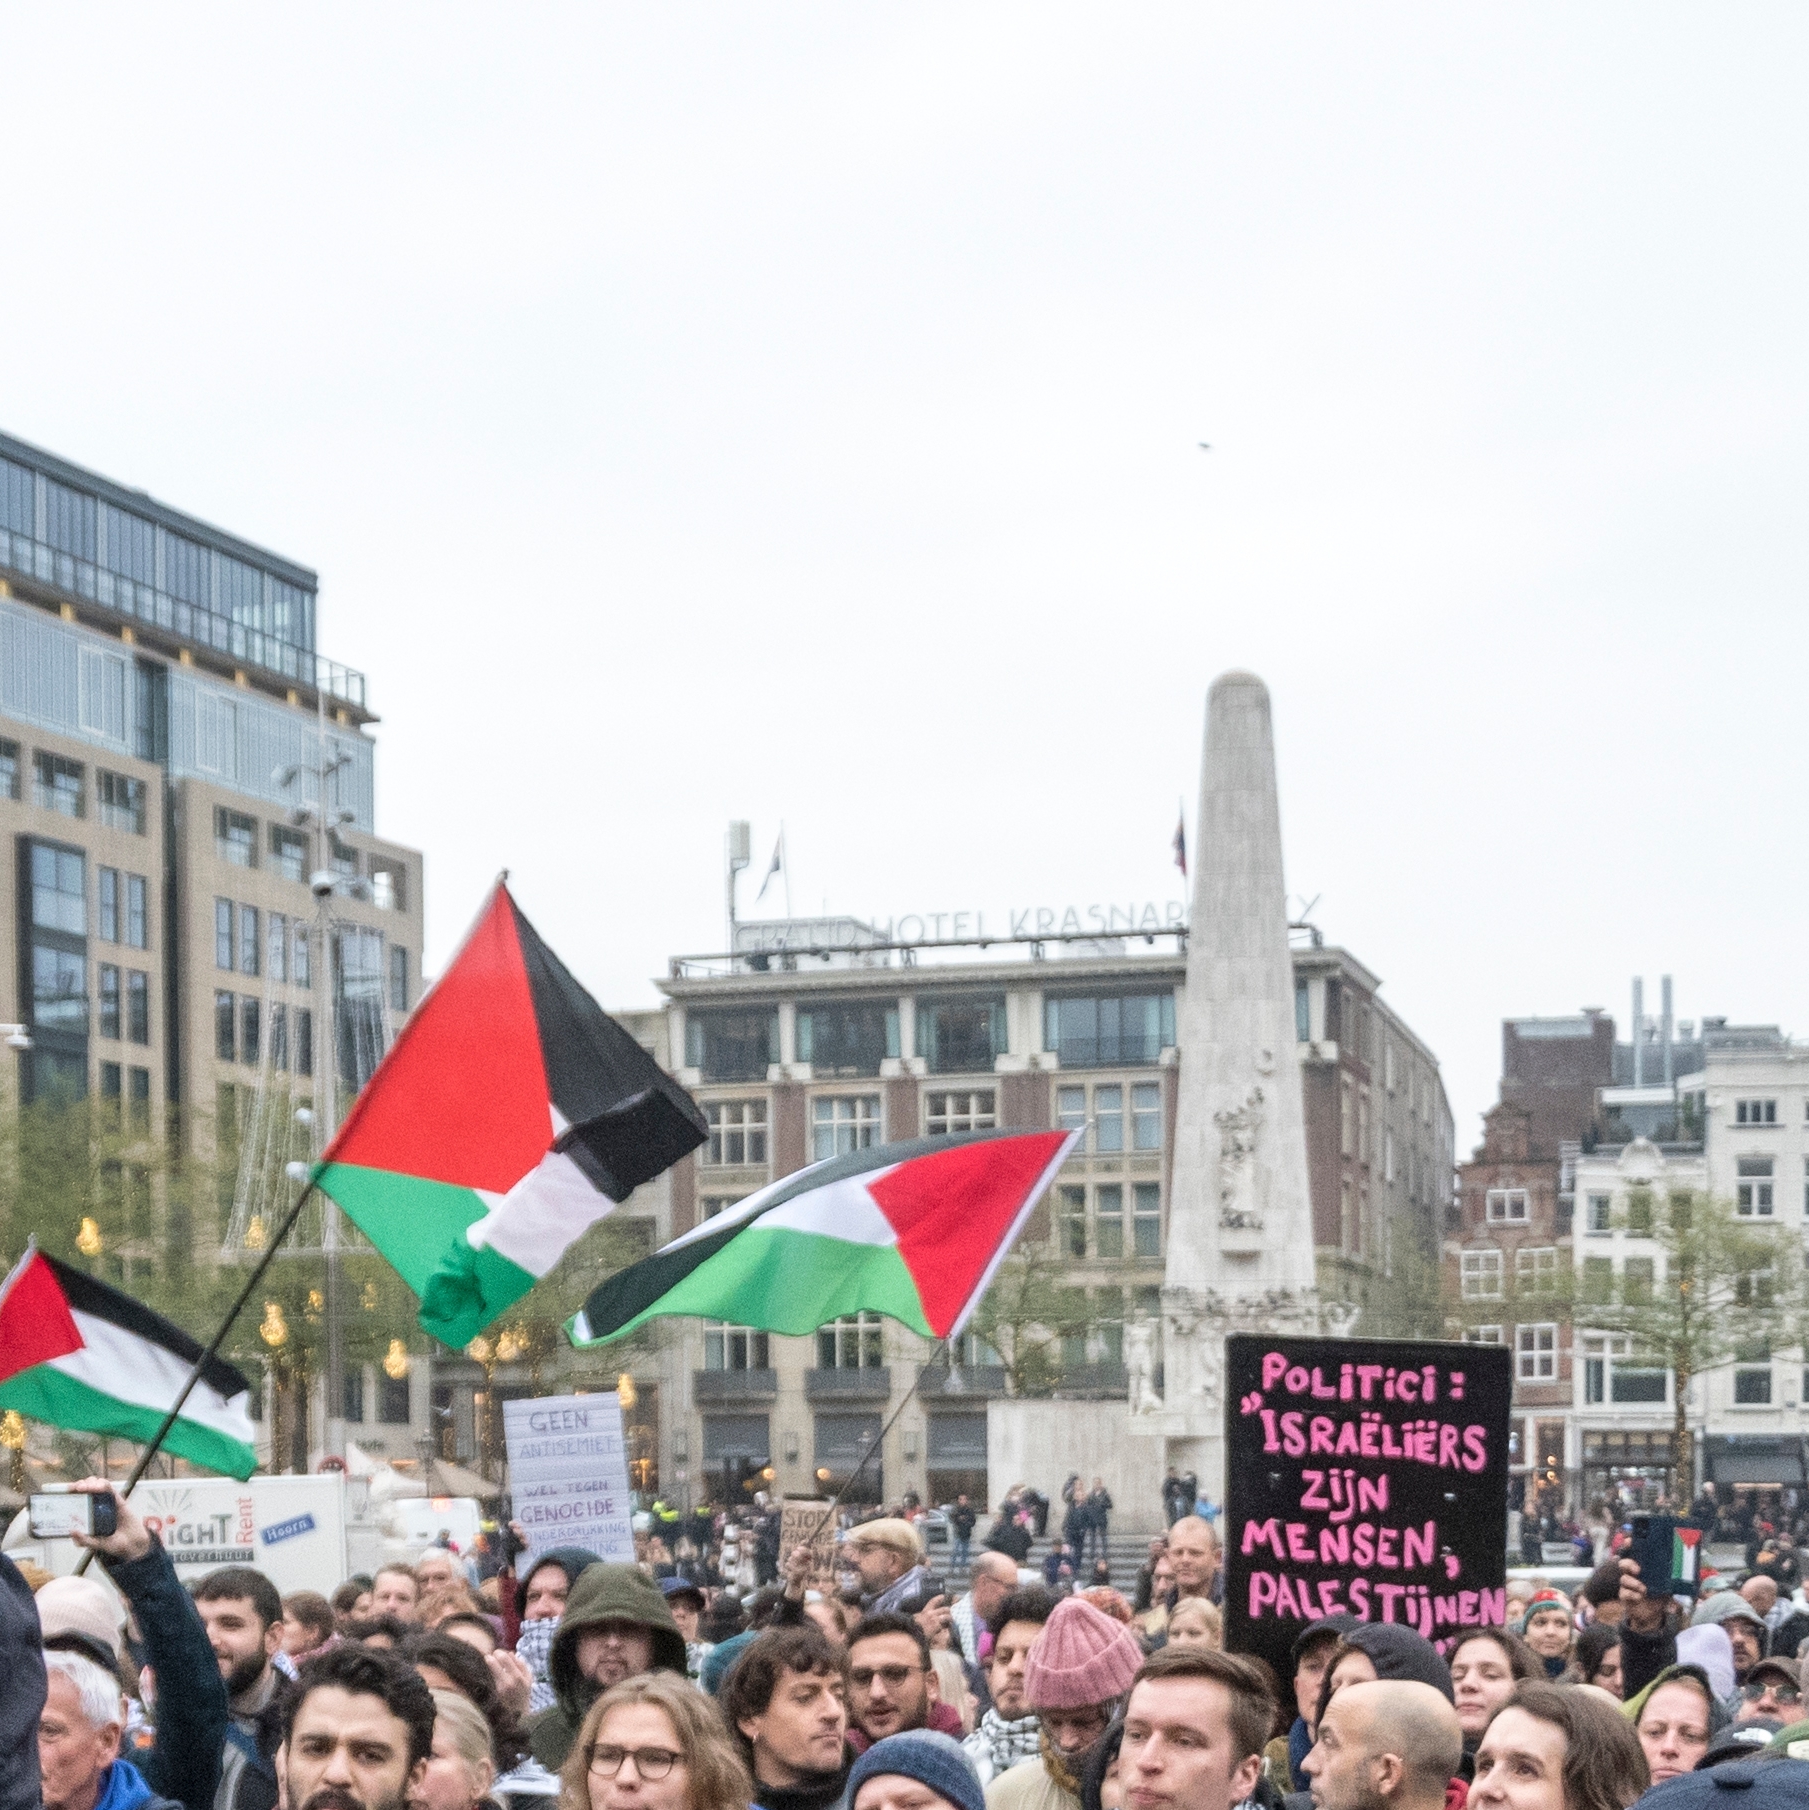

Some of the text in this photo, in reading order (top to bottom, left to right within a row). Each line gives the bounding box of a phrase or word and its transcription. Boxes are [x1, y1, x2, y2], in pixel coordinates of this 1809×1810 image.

[1009, 893, 1322, 934] KRASNAPY
[529, 1408, 589, 1432] GEEN
[519, 1435, 614, 1460] ANTISEMIET
[525, 1479, 609, 1498] WEL TEGEN
[519, 1498, 615, 1523] GENOCIDE
[265, 1518, 309, 1543] Hoorn
